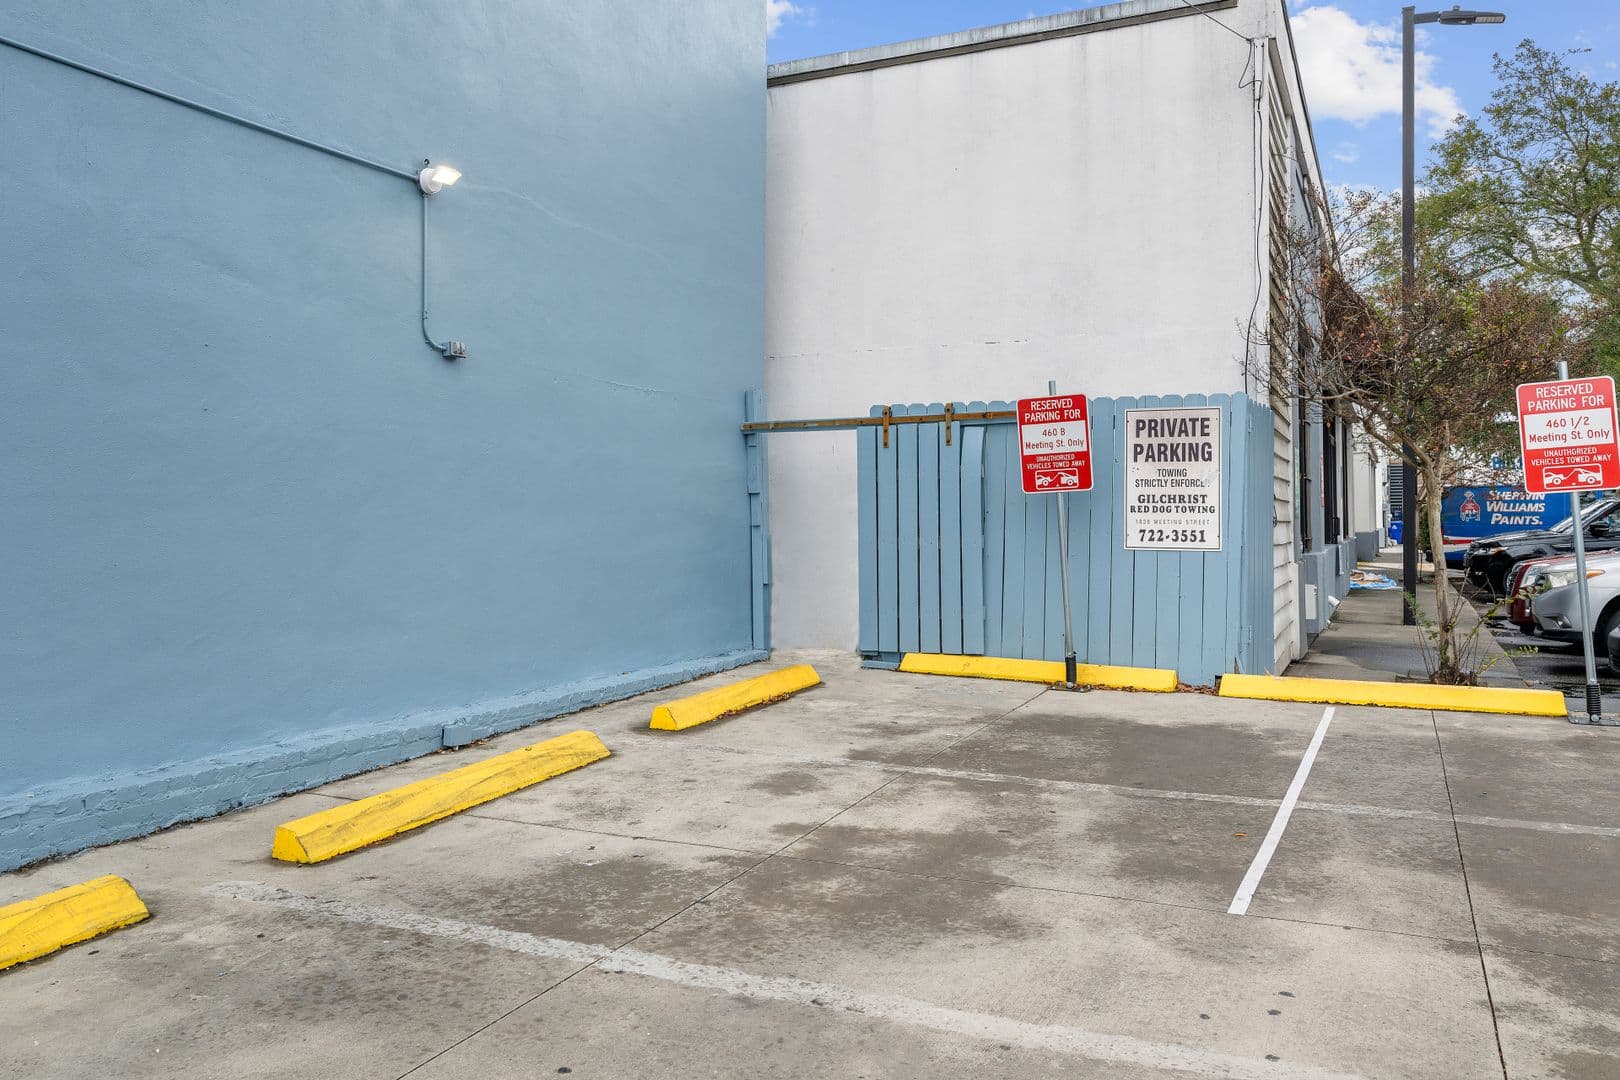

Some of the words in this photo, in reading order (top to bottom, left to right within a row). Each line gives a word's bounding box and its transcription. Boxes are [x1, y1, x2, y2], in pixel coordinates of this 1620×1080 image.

[1536, 382, 1593, 398] RESERVED
[1031, 398, 1073, 411] RESERVED
[1527, 397, 1576, 412] PARKING
[1581, 394, 1605, 407] FOR
[1024, 410, 1060, 423] PARKING
[1064, 409, 1081, 420] FOR
[1135, 418, 1210, 438] PRIVATE
[1546, 418, 1566, 428] 460
[1571, 416, 1590, 430] 1/2
[1042, 428, 1058, 437] 460
[1060, 428, 1066, 436] B
[1529, 432, 1567, 443] Meeting
[1571, 430, 1583, 440] St.
[1587, 428, 1610, 439] Only
[1025, 440, 1054, 450] Meeting
[1056, 440, 1066, 448] St.
[1067, 438, 1085, 448] Only
[1133, 442, 1213, 463] PARKING
[1544, 446, 1597, 457] UNAUTHORIZED
[1036, 454, 1075, 462] UNAUTHORIZED
[1531, 457, 1564, 466] VEHICLES
[1567, 456, 1590, 464] TOWED
[1592, 454, 1612, 462] AWAY
[1026, 462, 1052, 470] VEHICLES
[1157, 468, 1187, 478] TOWING
[1135, 478, 1168, 488] STRICTLY
[1137, 494, 1208, 504] GILCHRIST
[1130, 505, 1150, 514] RED
[1152, 505, 1172, 514] DOG
[1174, 505, 1216, 514] TOWING
[1486, 501, 1546, 512] WILLIAMS
[1491, 513, 1543, 525] PAINTS.
[1139, 529, 1206, 543] 722-3551
